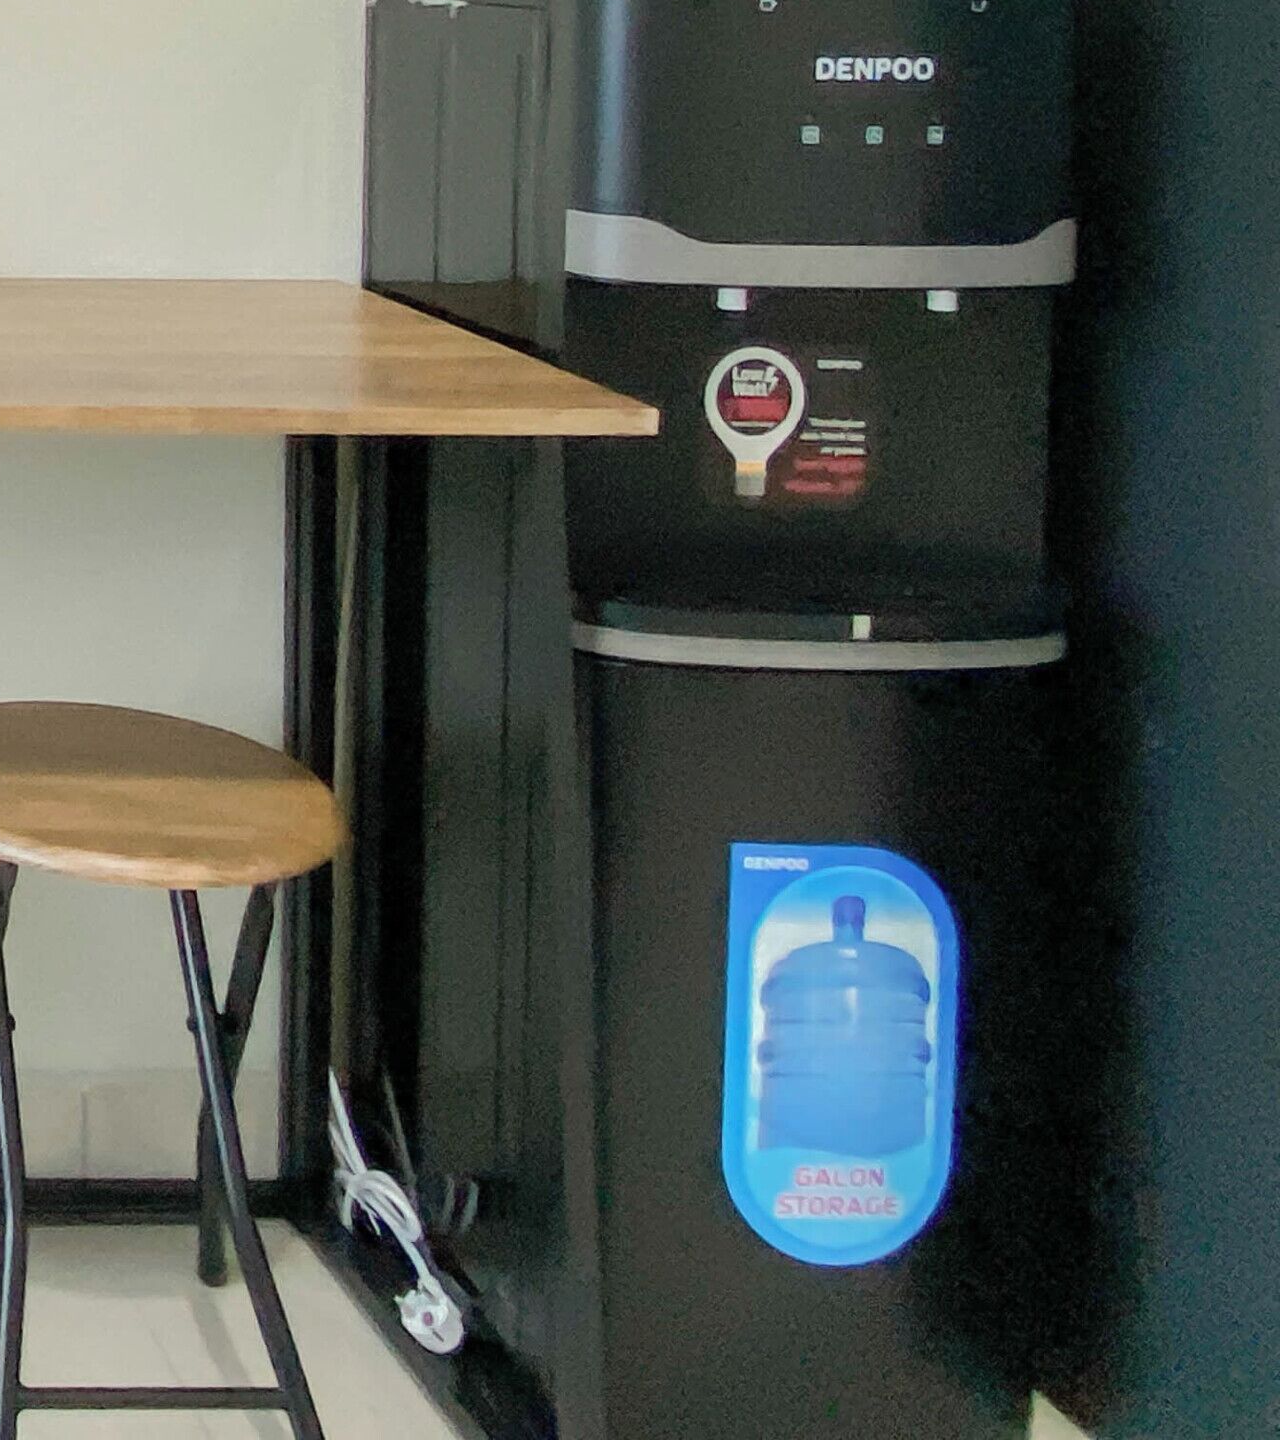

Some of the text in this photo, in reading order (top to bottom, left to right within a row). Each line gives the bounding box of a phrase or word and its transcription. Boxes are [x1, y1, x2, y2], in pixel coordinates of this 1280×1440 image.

[815, 56, 935, 82] DENPOO
[794, 1166, 885, 1187] GALON
[776, 1194, 898, 1216] STORAGE
